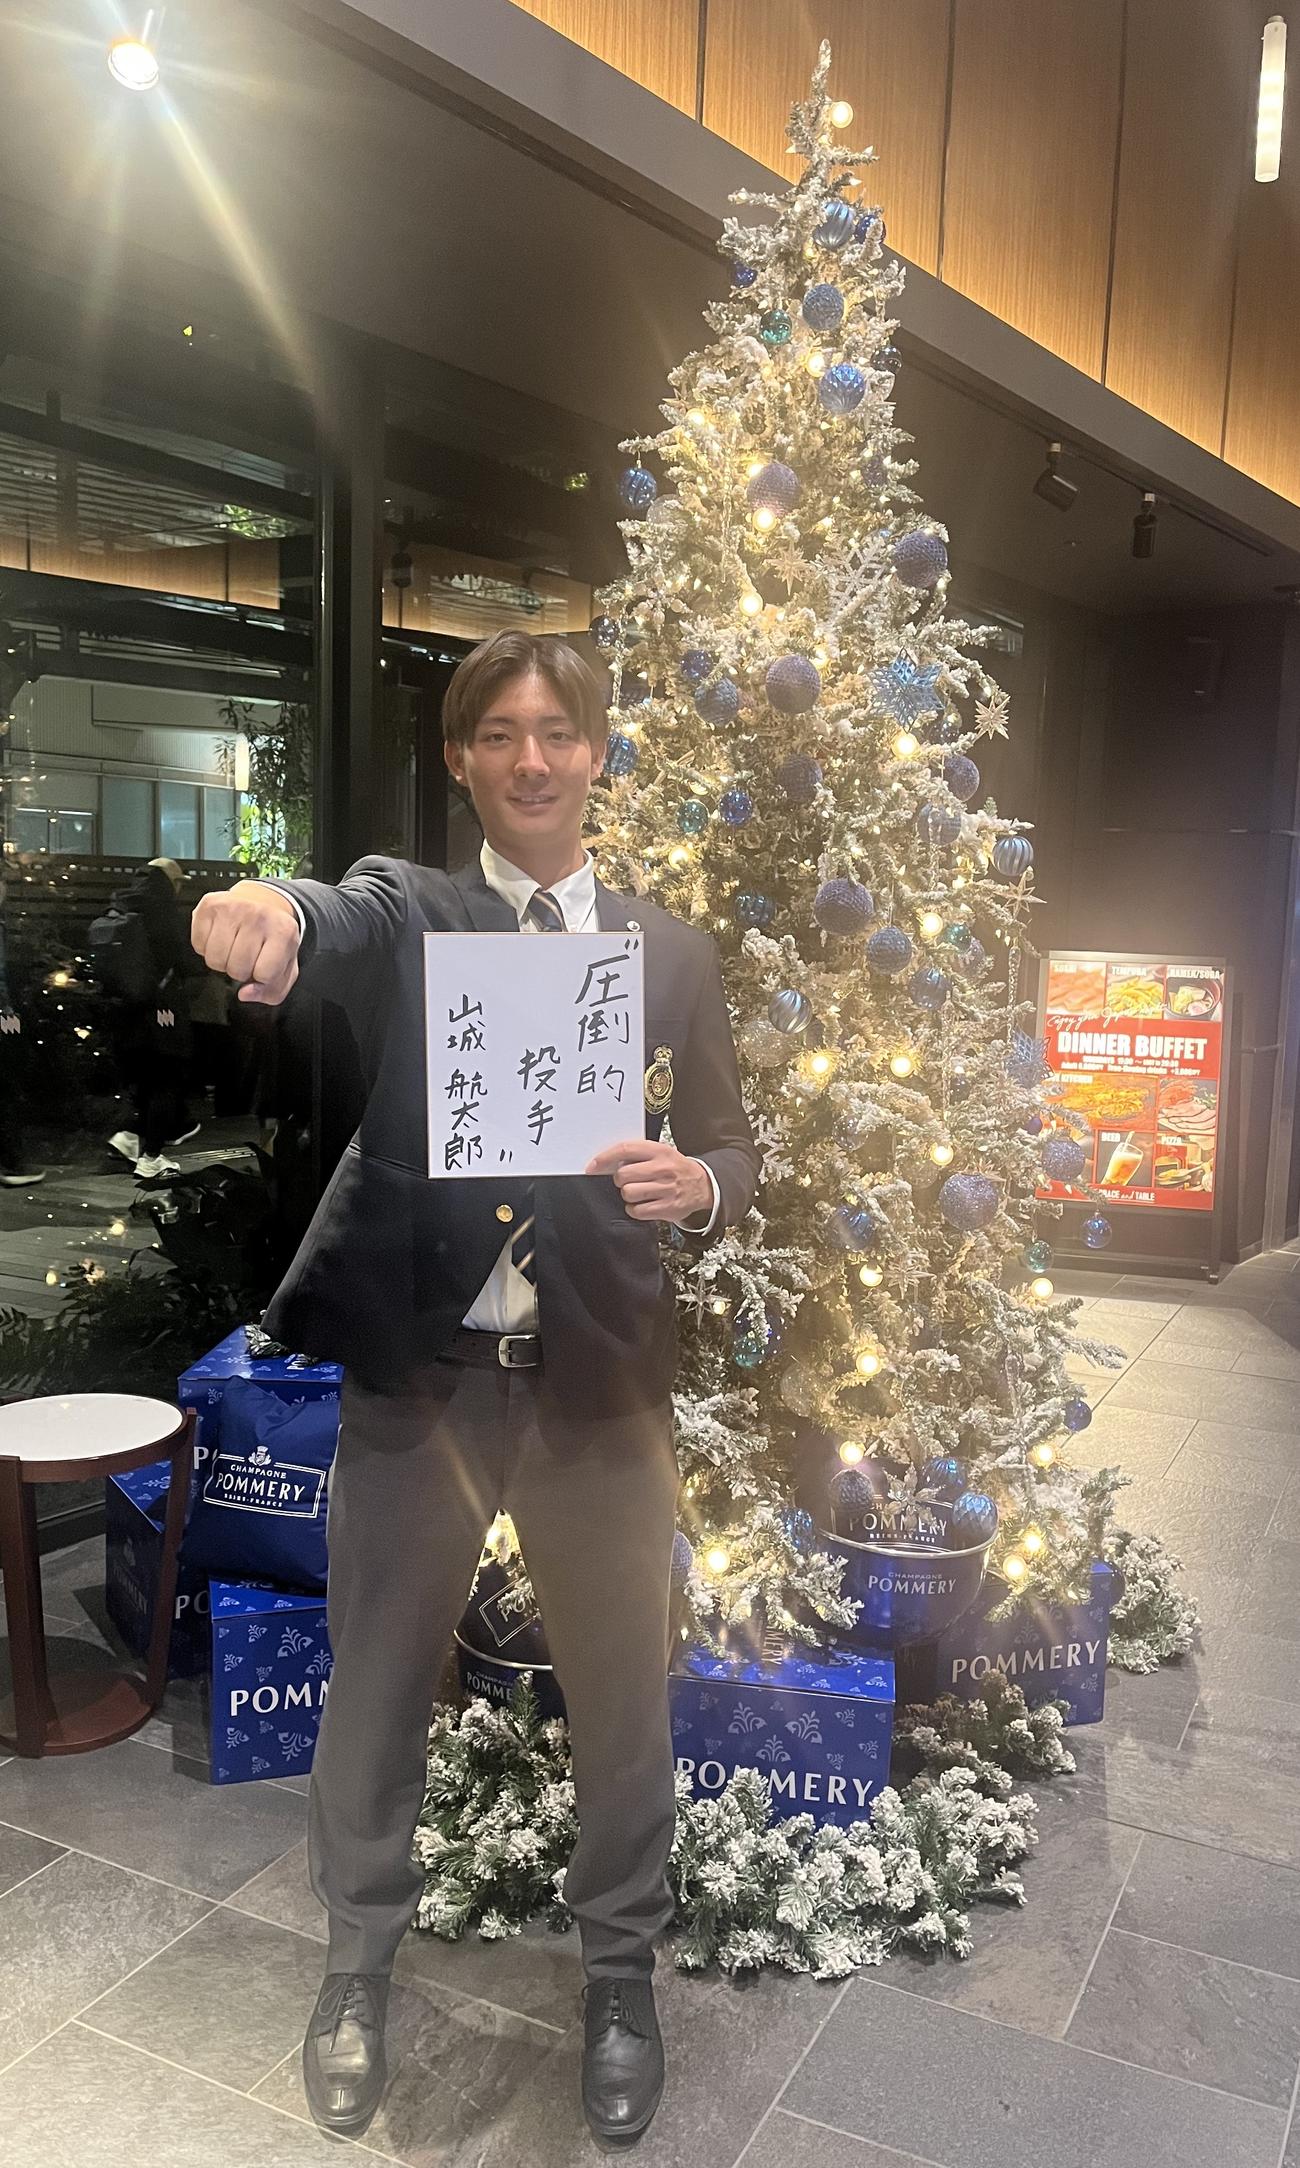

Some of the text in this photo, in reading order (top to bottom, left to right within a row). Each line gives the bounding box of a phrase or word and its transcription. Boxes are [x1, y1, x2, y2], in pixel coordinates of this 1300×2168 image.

[1058, 1031, 1208, 1060] DINNER BUFFET
[1135, 1191, 1155, 1201] TABLE
[230, 1464, 287, 1479] CHAMPAGNE
[215, 1472, 306, 1502] POMMERY
[868, 1575, 957, 1595] POMMERY
[888, 1572, 942, 1580] CHAMPAGNE
[951, 1640, 1101, 1684] POMMERY
[676, 1757, 873, 1807] POMERY
